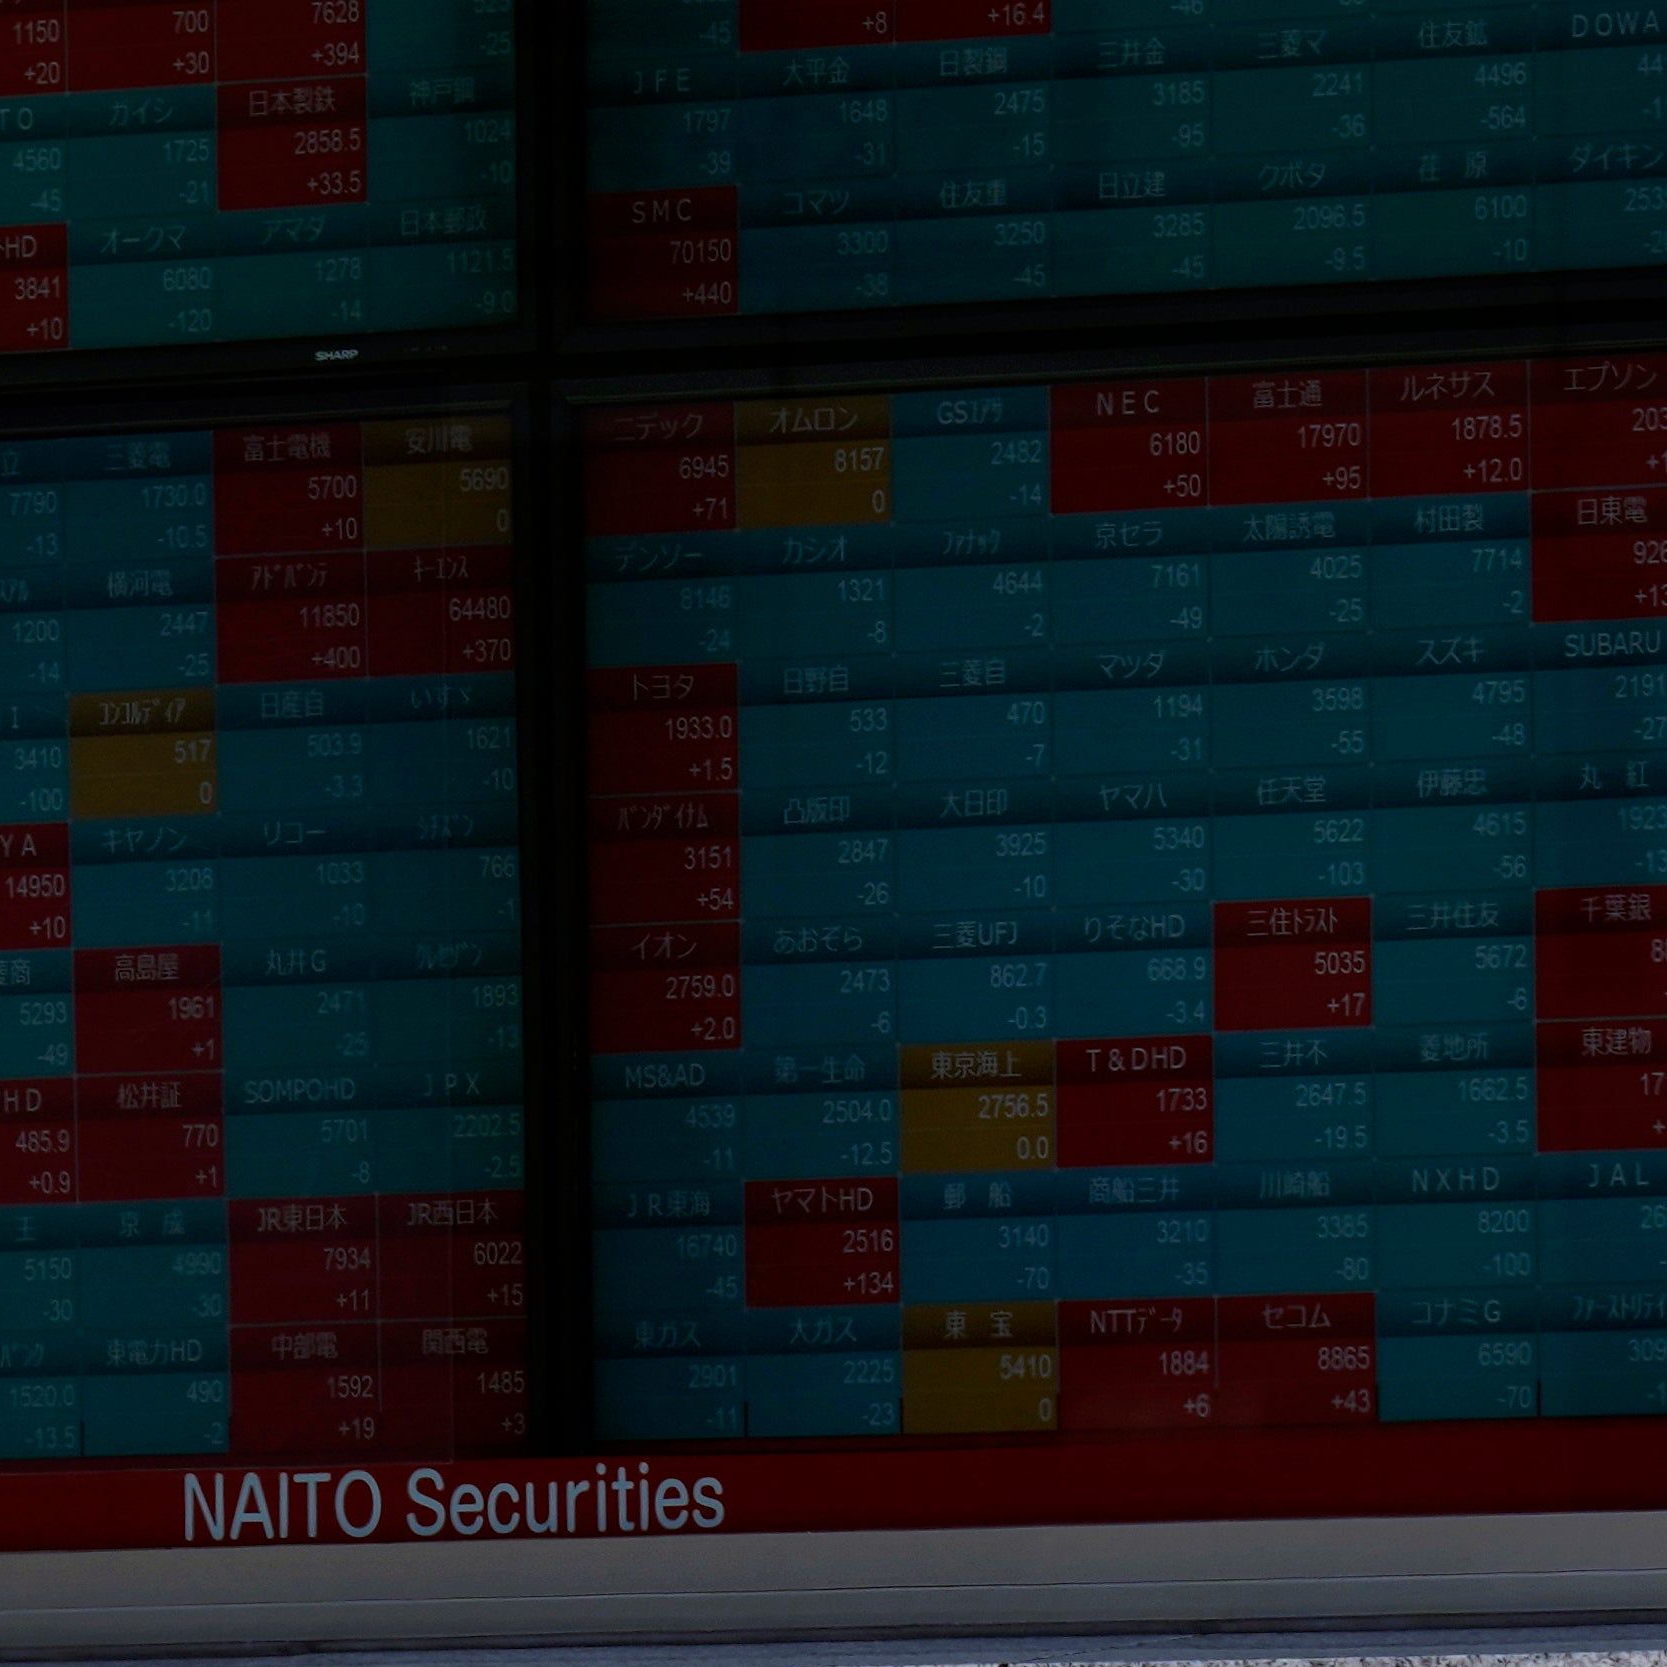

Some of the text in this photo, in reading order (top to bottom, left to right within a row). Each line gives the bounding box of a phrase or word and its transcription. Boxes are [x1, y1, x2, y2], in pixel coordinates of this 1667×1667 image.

[173, 9, 208, 34] 700
[312, 1, 359, 23] 7628
[862, 11, 887, 35] +8
[987, 3, 1045, 25] +16.4
[1572, 11, 1660, 38] DOWA
[13, 20, 60, 45] 1150
[173, 51, 209, 76] +30
[311, 41, 359, 66] +394
[23, 62, 60, 86] +20
[249, 87, 335, 117] 日本製鉄
[294, 128, 361, 155] 2858.5
[306, 172, 361, 195] +33.5
[631, 198, 692, 224] SMC
[670, 239, 732, 264] 70150
[15, 278, 61, 301] 3841
[683, 281, 732, 304] +440
[26, 317, 62, 342] +10
[314, 348, 360, 362] SHARP
[1401, 371, 1495, 401] ルネサス
[1564, 360, 1657, 392] エプソン
[1096, 389, 1160, 417] NEC
[1253, 380, 1323, 410] 富士通
[613, 411, 701, 442] ニデック
[770, 406, 858, 433] オムロン
[1451, 414, 1522, 442] 1878.5
[405, 425, 473, 454] 安川電
[1149, 430, 1200, 457] 6180
[1297, 422, 1361, 449] 17970
[243, 435, 331, 462] 富士電機
[834, 446, 883, 472] 8157
[678, 454, 729, 479] 6945
[1322, 466, 1361, 491] +95
[1464, 457, 1522, 483] +12.0
[308, 475, 357, 500] 5700
[460, 467, 509, 492] 5690
[1162, 473, 1201, 498] +50
[693, 499, 729, 521] +71
[872, 490, 884, 514] 0
[1577, 496, 1648, 526] 日東電
[321, 517, 358, 542] +10
[496, 510, 508, 532] 0
[449, 597, 511, 622] 64480
[462, 639, 511, 662] +370
[1418, 637, 1484, 667] スズキ
[1565, 631, 1660, 657] SUBARU
[311, 646, 360, 671] +400
[1254, 642, 1324, 672] ホンダ
[632, 674, 694, 702] トヨタ
[664, 716, 732, 739] 1933.0
[174, 740, 210, 763] 517
[688, 757, 732, 782] +1.5
[199, 782, 213, 805] 0
[1257, 776, 1326, 806] 任天堂
[683, 847, 732, 870] 3151
[4, 873, 65, 898] 14950
[696, 888, 733, 912] +54
[1582, 893, 1652, 923] 千葉銀
[29, 917, 65, 940] +10
[632, 933, 696, 960] イオン
[114, 953, 180, 983] 高島屋
[1314, 951, 1365, 976] 5035
[666, 976, 734, 999] 2759.0
[168, 995, 215, 1020] 1961
[1328, 994, 1365, 1017] +17
[690, 1018, 734, 1041] +2.0
[192, 1039, 215, 1061] +1
[931, 1050, 1021, 1079] 東京海上
[118, 1082, 182, 1110] 松井証
[978, 1093, 1048, 1120] 2756.5
[1156, 1088, 1206, 1112] 1733
[15, 1130, 70, 1153] 485.9
[182, 1124, 219, 1148] 770
[1017, 1137, 1048, 1159] 0.0
[1168, 1131, 1207, 1155] +16
[29, 1171, 71, 1194] +0.9
[195, 1167, 218, 1189] +1
[258, 1204, 347, 1233] JR東日本
[407, 1198, 499, 1227] JR西日本
[474, 1241, 523, 1266] 6022
[843, 1229, 894, 1253] 2516
[323, 1246, 371, 1270] 7934
[843, 1272, 894, 1295] +134
[336, 1290, 370, 1313] +11
[487, 1285, 523, 1308] +15
[1265, 1304, 1331, 1330] セコム
[272, 1332, 339, 1361] 中部電
[1318, 1346, 1369, 1371] 8865
[1001, 1354, 1050, 1380] 5410
[1159, 1350, 1208, 1375] 1884
[328, 1375, 372, 1400] 1592
[477, 1370, 525, 1395] 1485
[1039, 1399, 1051, 1422] 0
[1183, 1393, 1209, 1416] +6
[1331, 1389, 1370, 1414] +43
[338, 1416, 375, 1440] +19
[500, 1413, 525, 1435] +3
[184, 1461, 725, 1541] NAITO Securities
